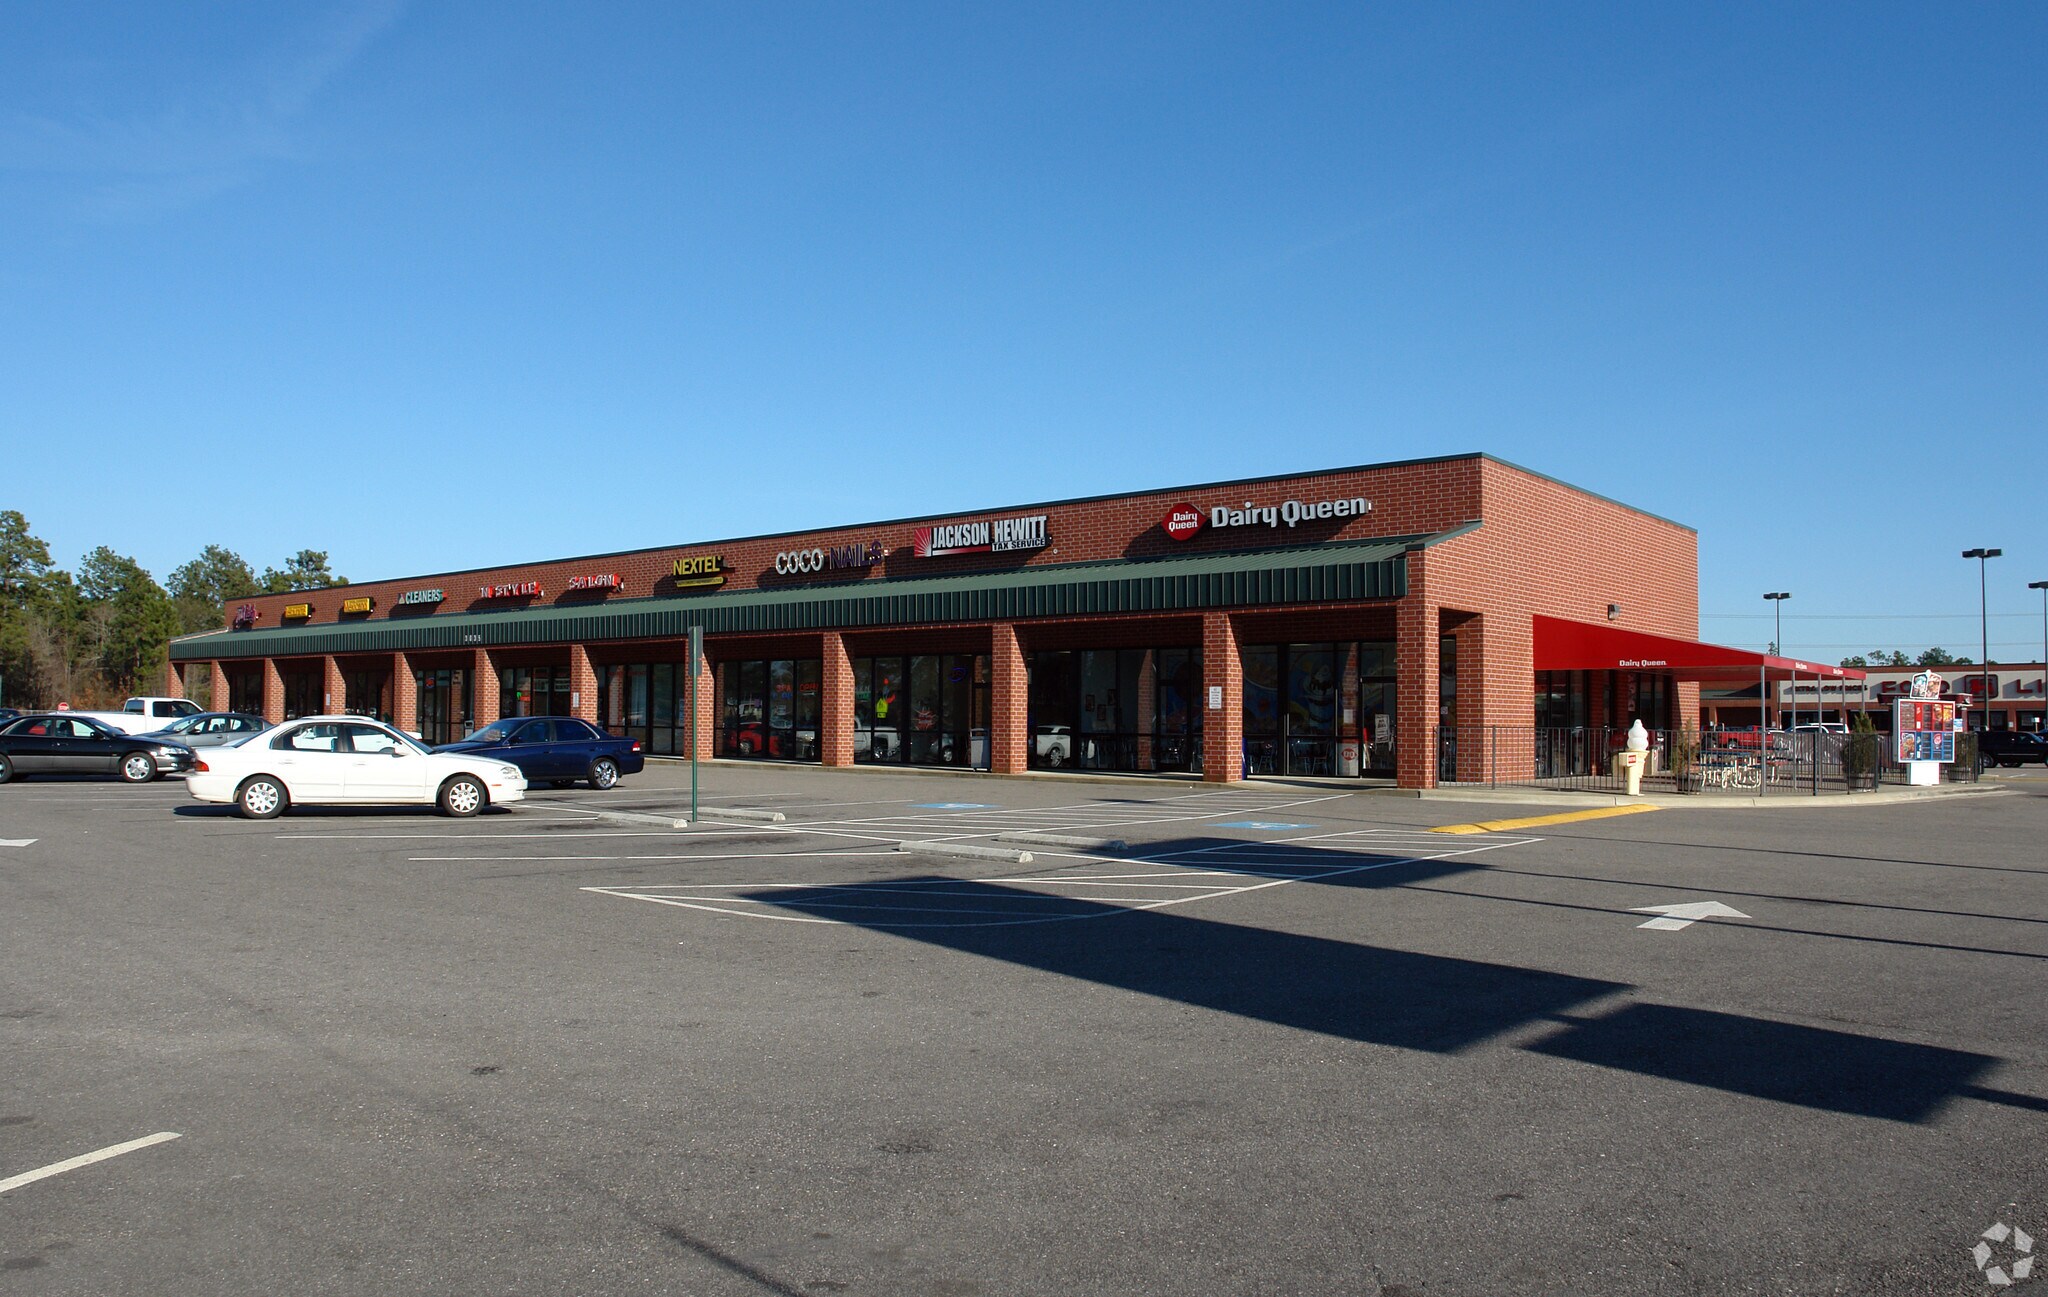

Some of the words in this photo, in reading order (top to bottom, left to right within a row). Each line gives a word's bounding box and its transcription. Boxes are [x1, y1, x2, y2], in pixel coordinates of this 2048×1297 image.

[1173, 511, 1198, 523] Dairy
[1211, 501, 1278, 528] Dairy
[1281, 497, 1366, 527] Queen
[932, 522, 989, 549] JACKSON
[994, 515, 1047, 543] HEWITT
[1168, 520, 1198, 532] Queen
[993, 541, 1009, 551] TAX
[1011, 537, 1046, 550] SERVICE
[673, 556, 720, 576] NEXTEL
[776, 548, 824, 575] COCO
[829, 541, 884, 570] NAILS
[569, 573, 615, 590] SALON
[405, 589, 441, 604] CLEANERS
[1619, 659, 1640, 668] Dairy
[1641, 659, 1666, 668] Queen
